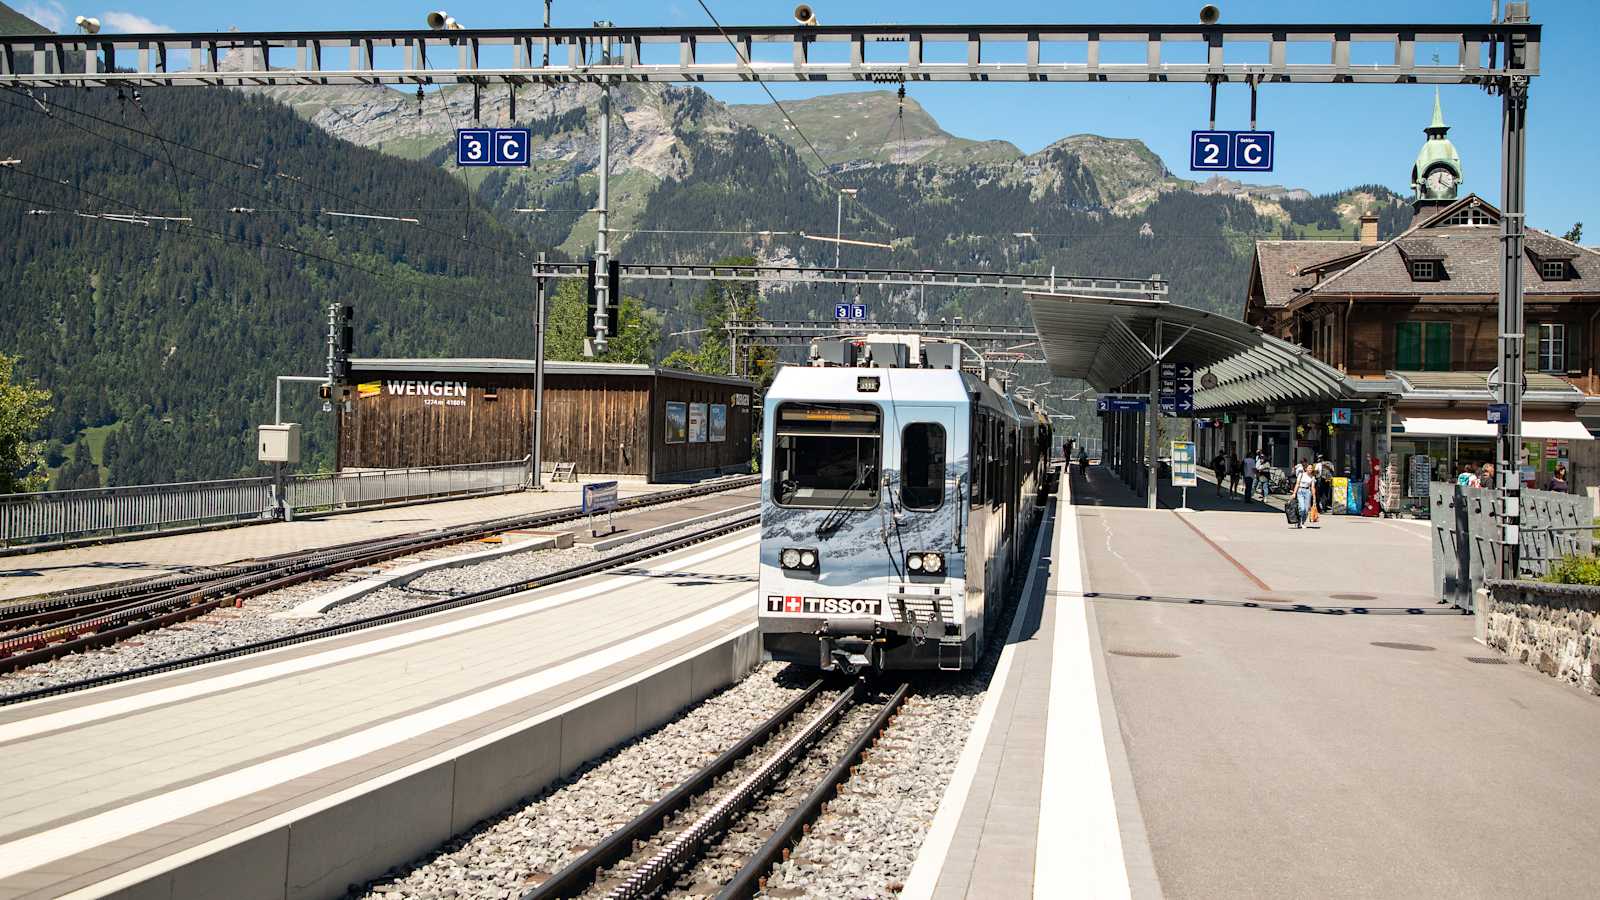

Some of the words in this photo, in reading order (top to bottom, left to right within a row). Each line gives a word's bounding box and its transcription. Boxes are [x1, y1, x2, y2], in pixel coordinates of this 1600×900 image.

[467, 140, 481, 160] 3
[503, 140, 519, 160] C
[1203, 143, 1219, 164] 2
[1244, 143, 1262, 165] C
[839, 308, 846, 317] 3
[387, 380, 467, 397] WENGEN
[1100, 402, 1106, 410] 2
[768, 597, 782, 611] T
[805, 598, 880, 615] TISSOT
